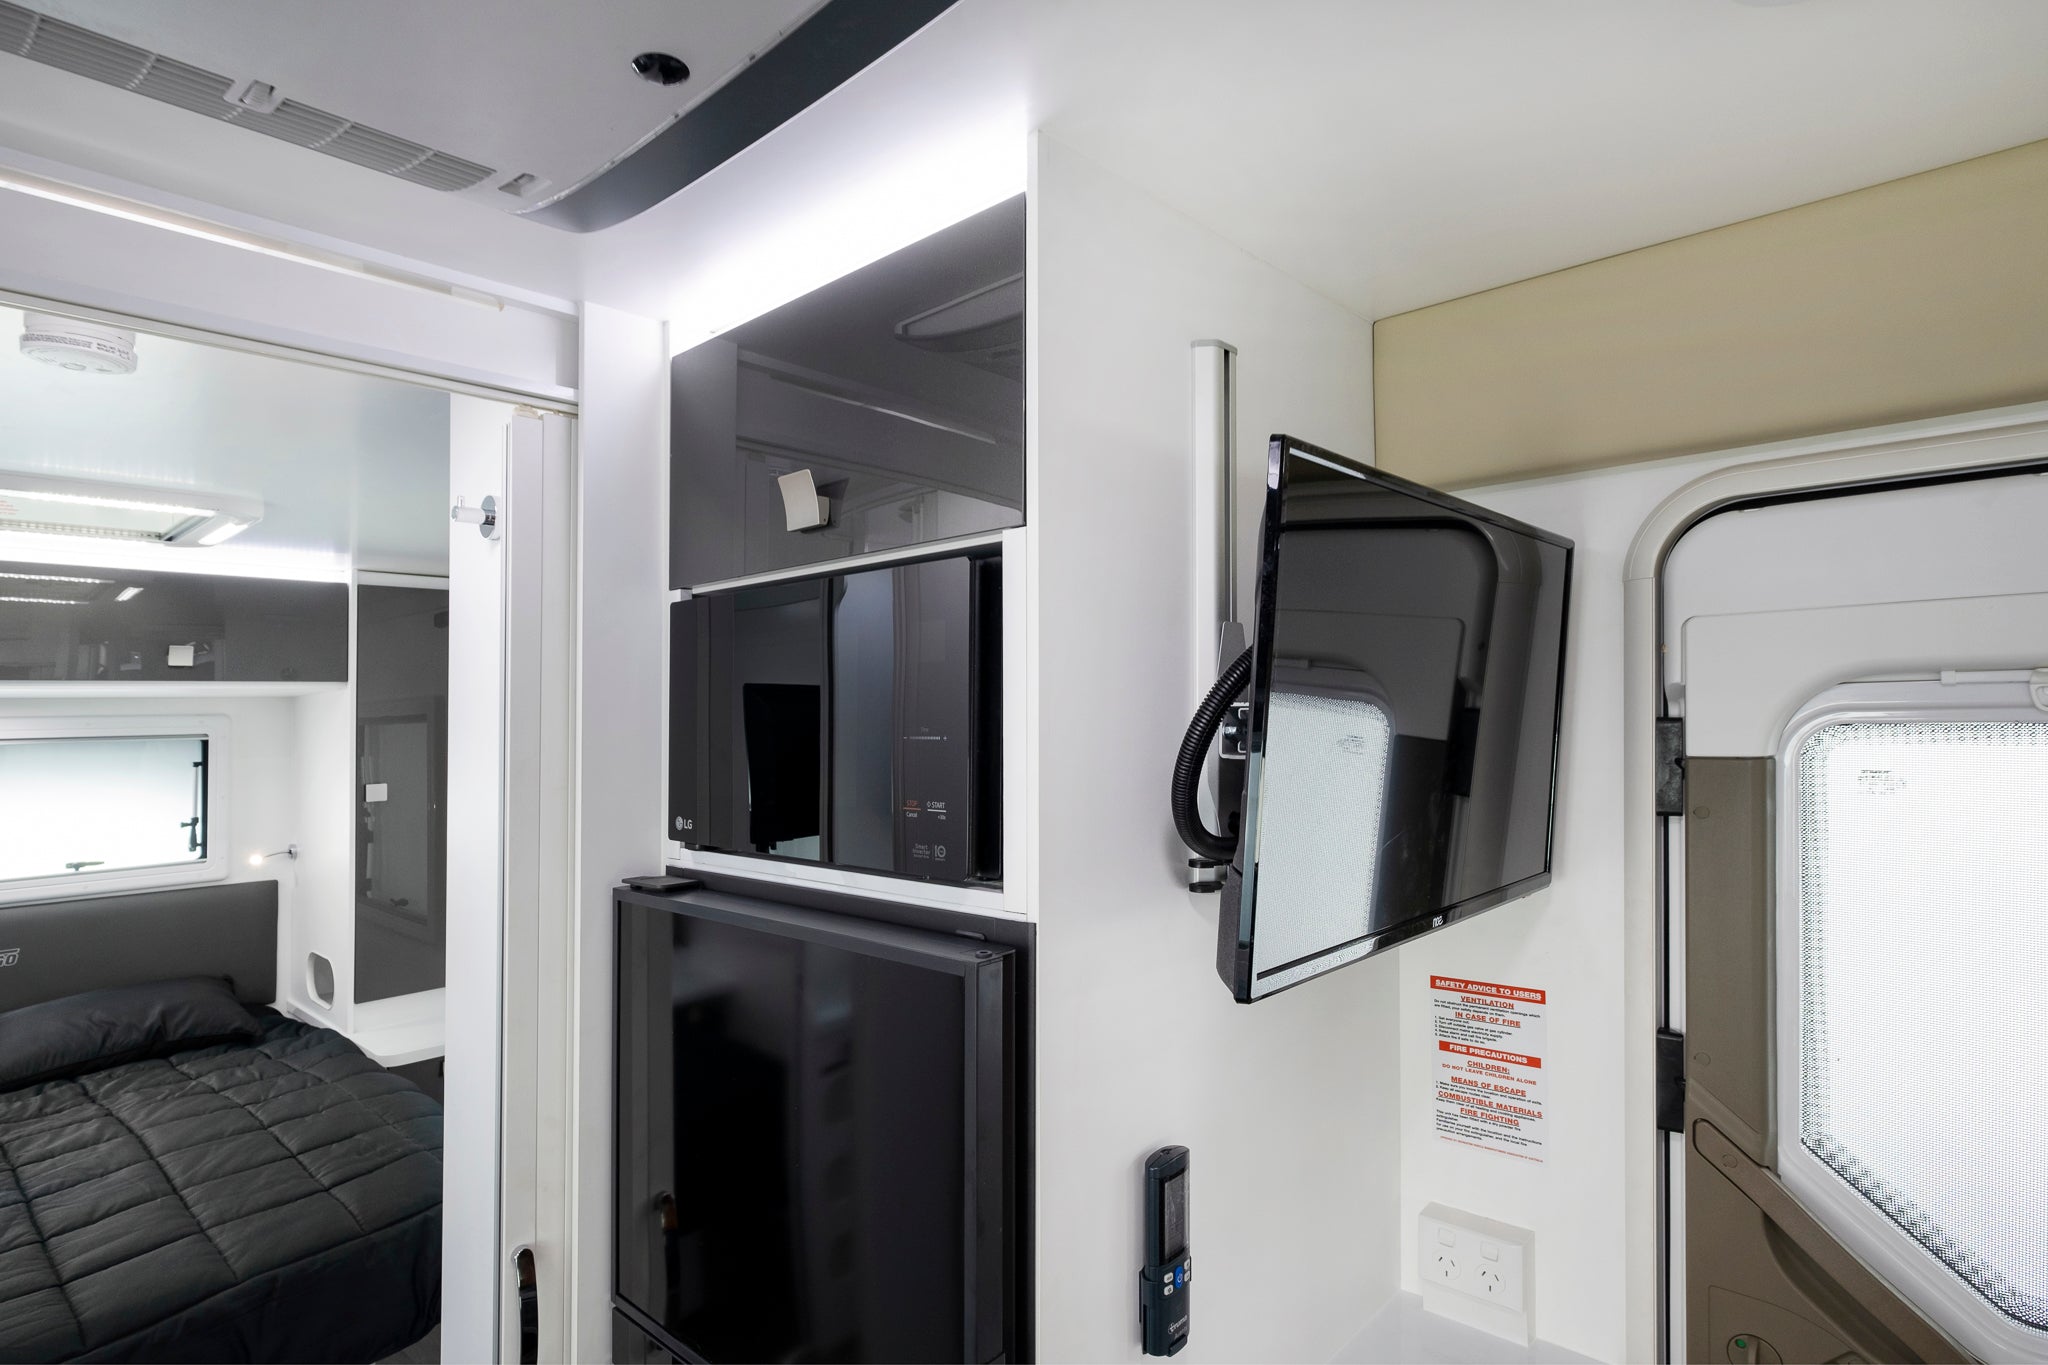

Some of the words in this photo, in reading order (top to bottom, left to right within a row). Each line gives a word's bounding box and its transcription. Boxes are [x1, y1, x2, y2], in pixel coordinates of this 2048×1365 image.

[932, 801, 945, 809] START
[1435, 979, 1466, 989] SAFETY
[1467, 983, 1497, 993] ADVICE
[1499, 987, 1512, 996] TO
[1513, 989, 1542, 1001] USERS
[1460, 995, 1515, 1009] VENTILATION
[1455, 1011, 1463, 1019] IN
[1465, 1013, 1486, 1022] CASE
[1489, 1016, 1500, 1024] OF
[1502, 1018, 1521, 1028] FIRE
[1449, 1044, 1468, 1053] FIRE
[1469, 1047, 1528, 1064] PRECAUTIONS
[1465, 1067, 1483, 1075] LEAVE
[1485, 1071, 1515, 1081] CHILDREN
[1516, 1078, 1537, 1086] ALONE
[1467, 1060, 1510, 1075] CHILDREN:
[1451, 1076, 1479, 1088] MEANS
[1480, 1082, 1491, 1090] OF
[1494, 1085, 1527, 1097] ESCAPE
[1438, 1090, 1494, 1108] COMBUSTIBLE
[1496, 1103, 1544, 1119] MATERIALS
[1460, 1107, 1478, 1117] FIRE
[1480, 1112, 1520, 1127] FIGHTING
